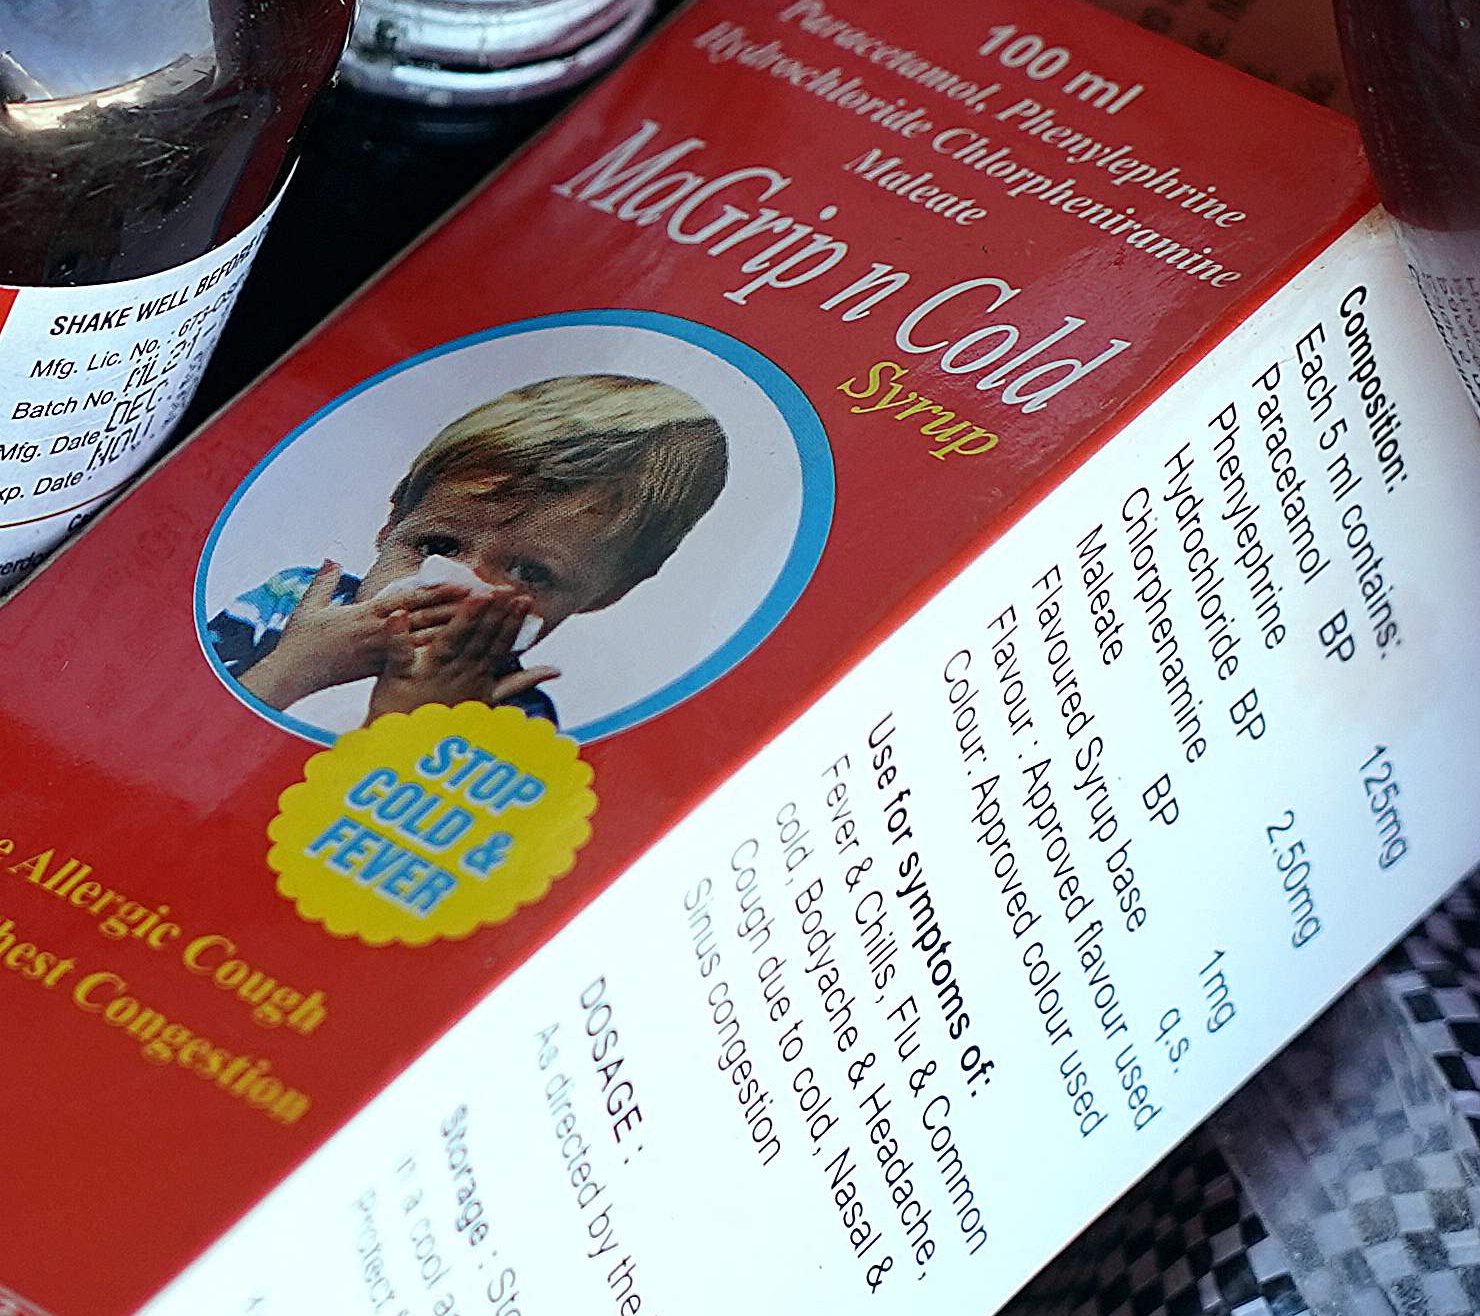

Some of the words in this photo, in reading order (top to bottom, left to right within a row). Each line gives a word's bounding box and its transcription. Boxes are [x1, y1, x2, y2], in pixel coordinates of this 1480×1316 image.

[979, 26, 1070, 80] 100
[1063, 71, 1144, 114] ml
[843, 149, 987, 225] Maleate
[932, 129, 1241, 287] Chlorpheniramine
[998, 99, 1247, 228] Phenylephrine
[49, 306, 135, 336] SHAKE
[134, 285, 193, 324] WELL
[553, 118, 850, 305] MaGrip
[819, 262, 910, 322] n
[895, 277, 1131, 411] Cold
[7, 397, 79, 425] Batch
[84, 389, 119, 410] No.
[29, 358, 76, 380] Mfg.
[86, 350, 120, 373] Lic.
[129, 338, 164, 360] No.
[836, 362, 1000, 460] Syrup
[33, 469, 84, 497] Date
[1207, 401, 1287, 650] Phenylephrine
[1295, 322, 1338, 423] Each
[1341, 503, 1401, 648] contains:
[1076, 523, 1125, 666] Maleate
[1121, 486, 1208, 764] Chlorphenamine
[1251, 361, 1331, 585] Paracetamol
[1318, 610, 1355, 663] BP
[1359, 744, 1408, 871] 125mg
[1163, 441, 1242, 682] Hydrochloride
[1265, 809, 1322, 950] 2.50mg
[341, 762, 477, 855] COLD
[466, 826, 512, 866] &
[412, 731, 552, 819] STOP
[1072, 735, 1119, 843] Syrup
[8, 849, 181, 948] Allergic
[182, 934, 325, 1031] Cough
[301, 814, 462, 922] FEVER
[867, 712, 898, 791] Use
[899, 851, 969, 1040] symptoms
[74, 971, 308, 1139] Congestion
[580, 976, 644, 1144] DOSAGE
[708, 981, 782, 1167] congestion
[794, 877, 859, 1053] Bodyache
[859, 1082, 936, 1281] Headache,
